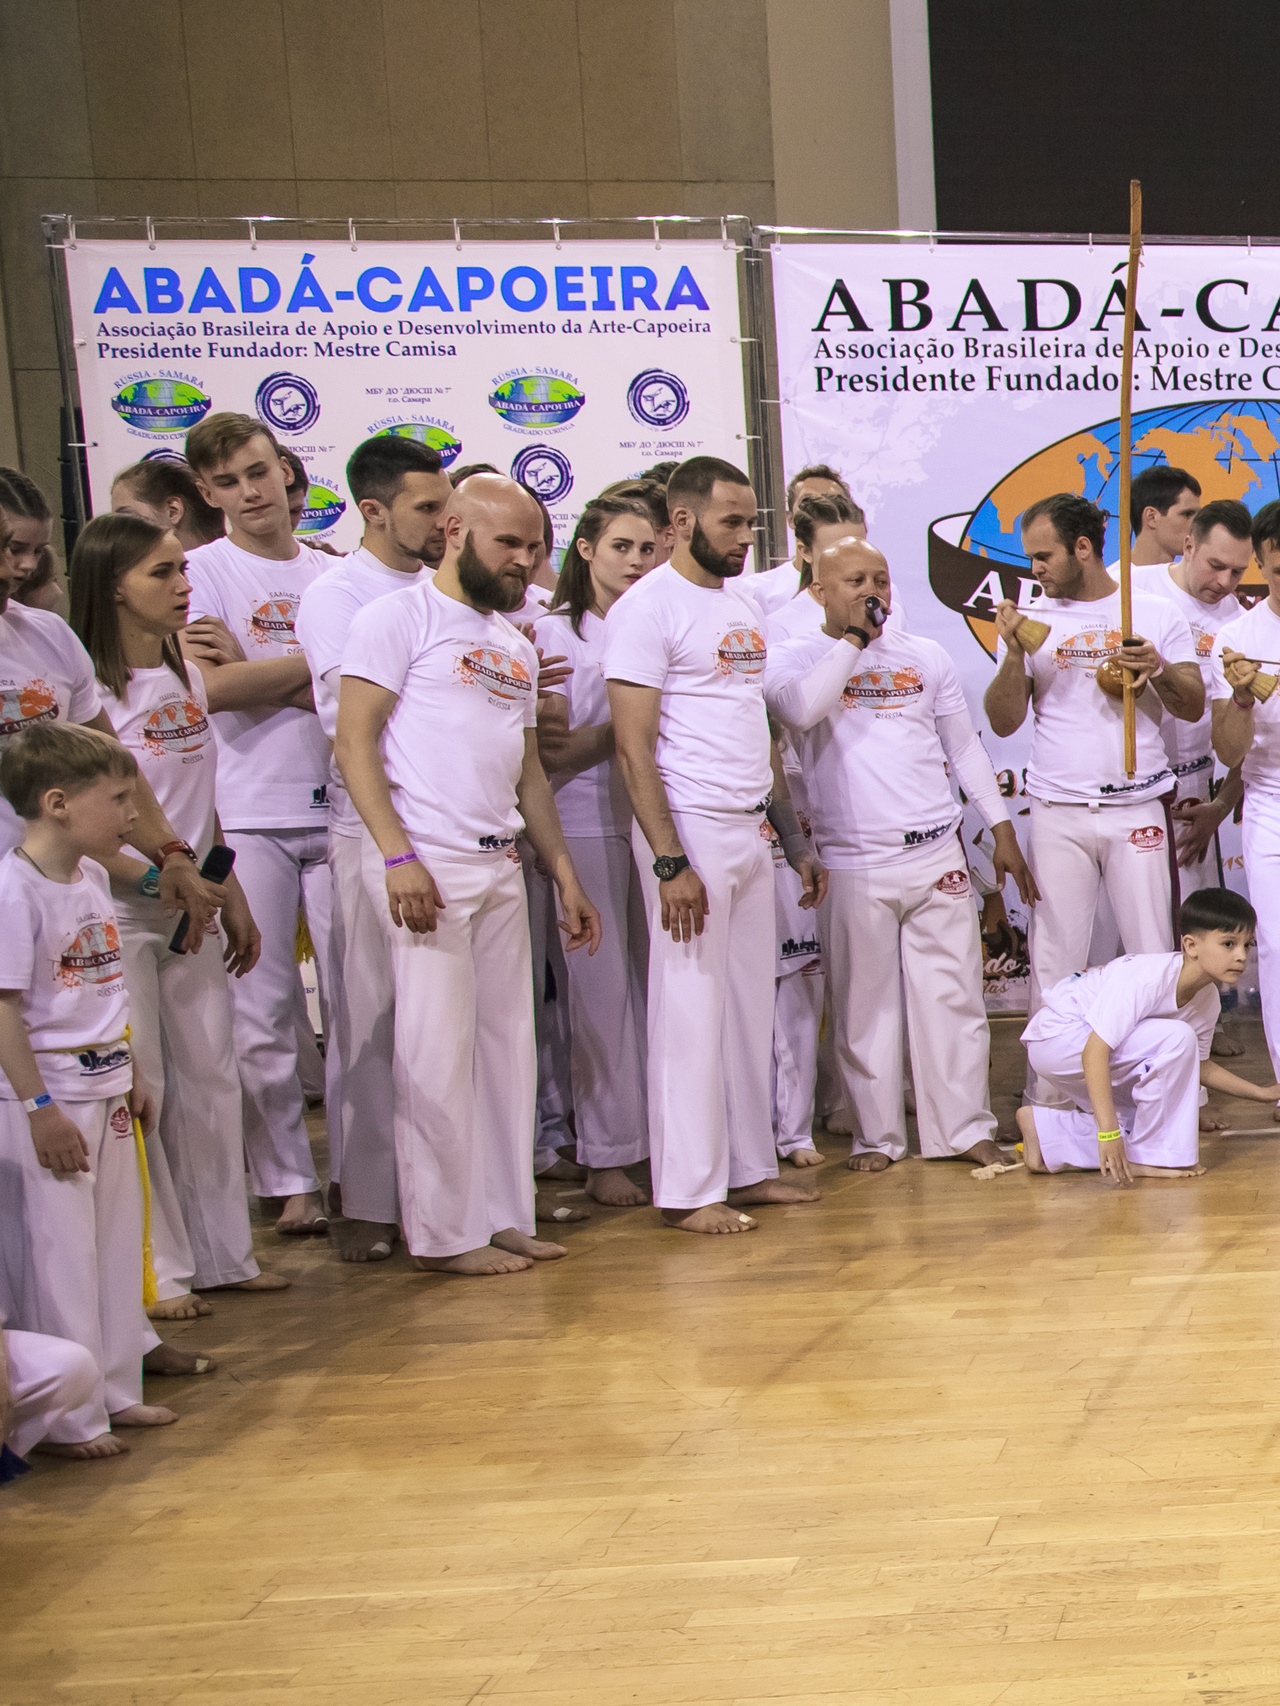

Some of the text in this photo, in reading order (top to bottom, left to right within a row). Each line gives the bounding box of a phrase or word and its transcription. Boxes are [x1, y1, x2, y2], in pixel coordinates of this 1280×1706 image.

[93, 253, 710, 314] ABADÁ-CAPOEIRA
[96, 318, 711, 341] Associação Brasileira de Apoio e Desenvolvimento da Arte-Capoeira
[97, 340, 457, 359] Presidente Fundador: Mestre Camisa
[814, 337, 955, 364] Associação
[963, 337, 1087, 359] Brasileira
[1096, 336, 1124, 358] de
[1134, 337, 1210, 364] Apoio
[1219, 344, 1231, 358] e
[159, 369, 204, 389] SAMARA
[535, 366, 578, 385] SAMARA
[814, 365, 976, 392] Presidente
[985, 365, 1140, 392] Fundado:
[1150, 365, 1253, 391] Mestre
[411, 414, 455, 433] SAMARA
